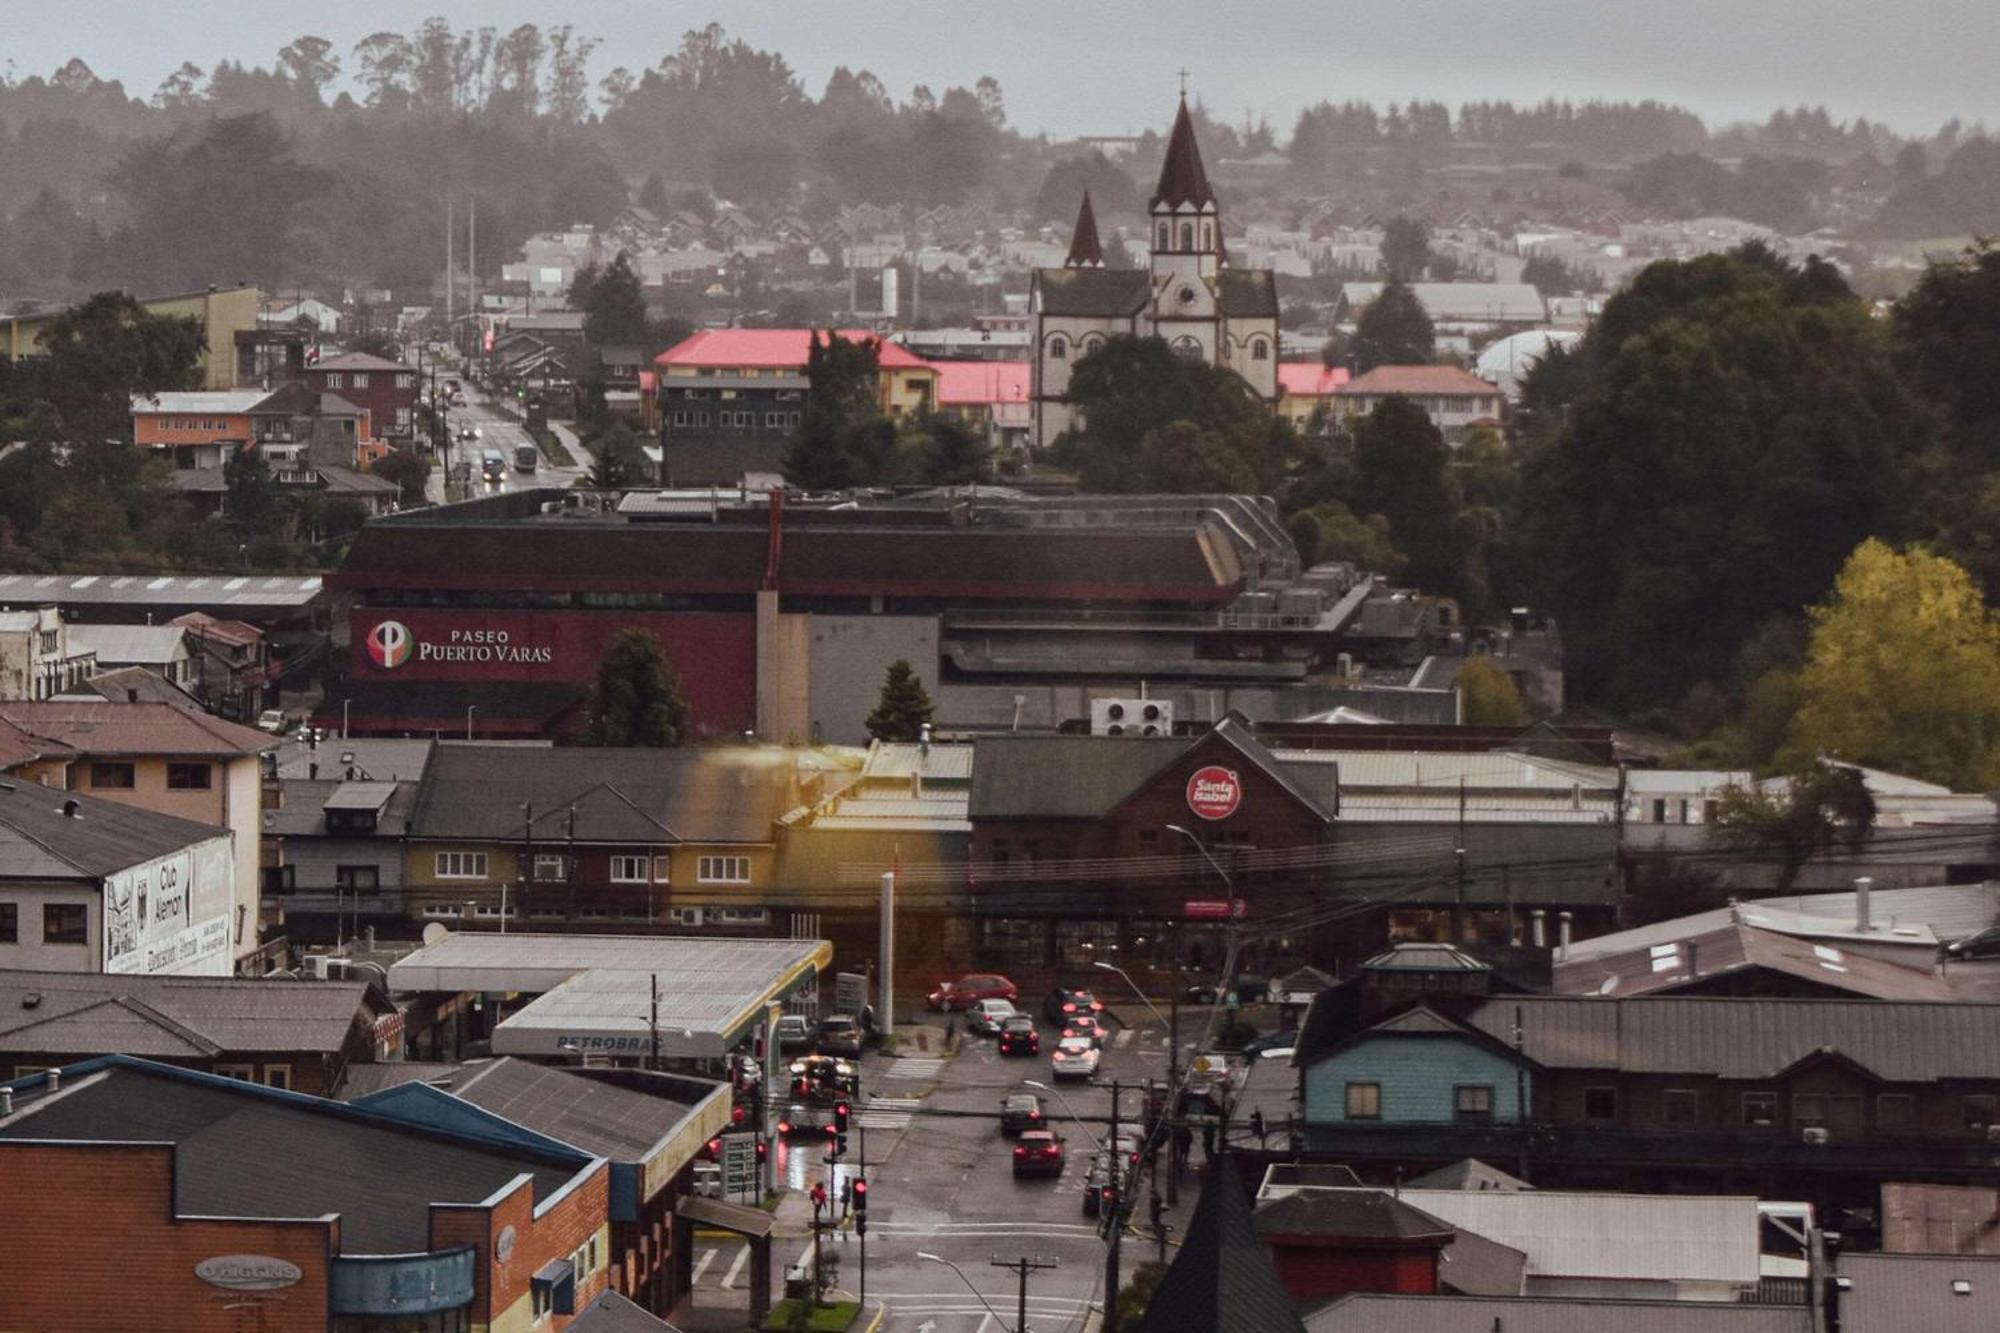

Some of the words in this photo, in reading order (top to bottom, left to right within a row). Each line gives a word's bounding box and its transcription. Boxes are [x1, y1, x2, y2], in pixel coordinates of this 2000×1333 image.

[451, 630, 509, 643] PASEO
[419, 642, 490, 661] PUERTO
[495, 644, 552, 662] VARAS
[1195, 779, 1235, 793] Santa
[159, 863, 177, 891] Club
